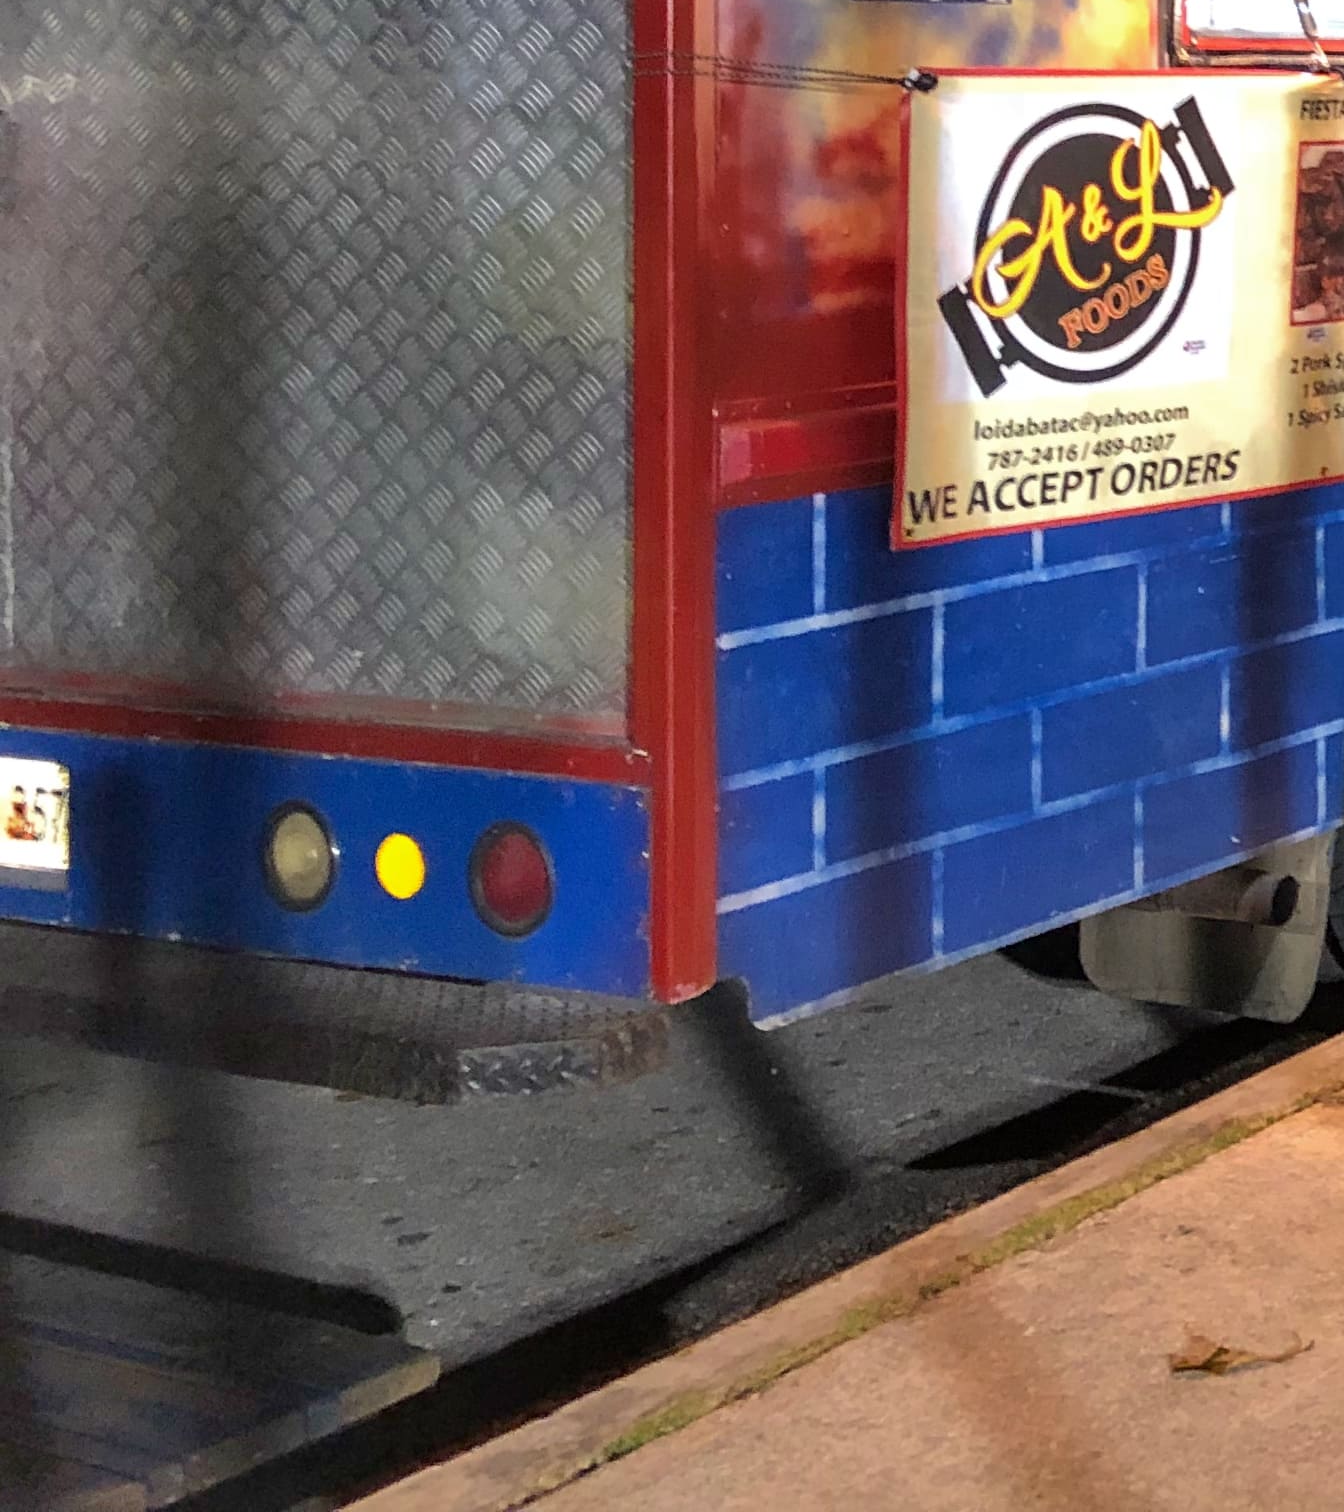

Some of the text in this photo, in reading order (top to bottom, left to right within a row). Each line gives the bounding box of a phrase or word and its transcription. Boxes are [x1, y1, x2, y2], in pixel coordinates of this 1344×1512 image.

[1058, 252, 1169, 348] FOODS
[1302, 355, 1332, 372] Pork
[974, 405, 1190, 441] loidabatac@yahoo.com
[908, 449, 1242, 525] WE ACCEPT ORDERS
